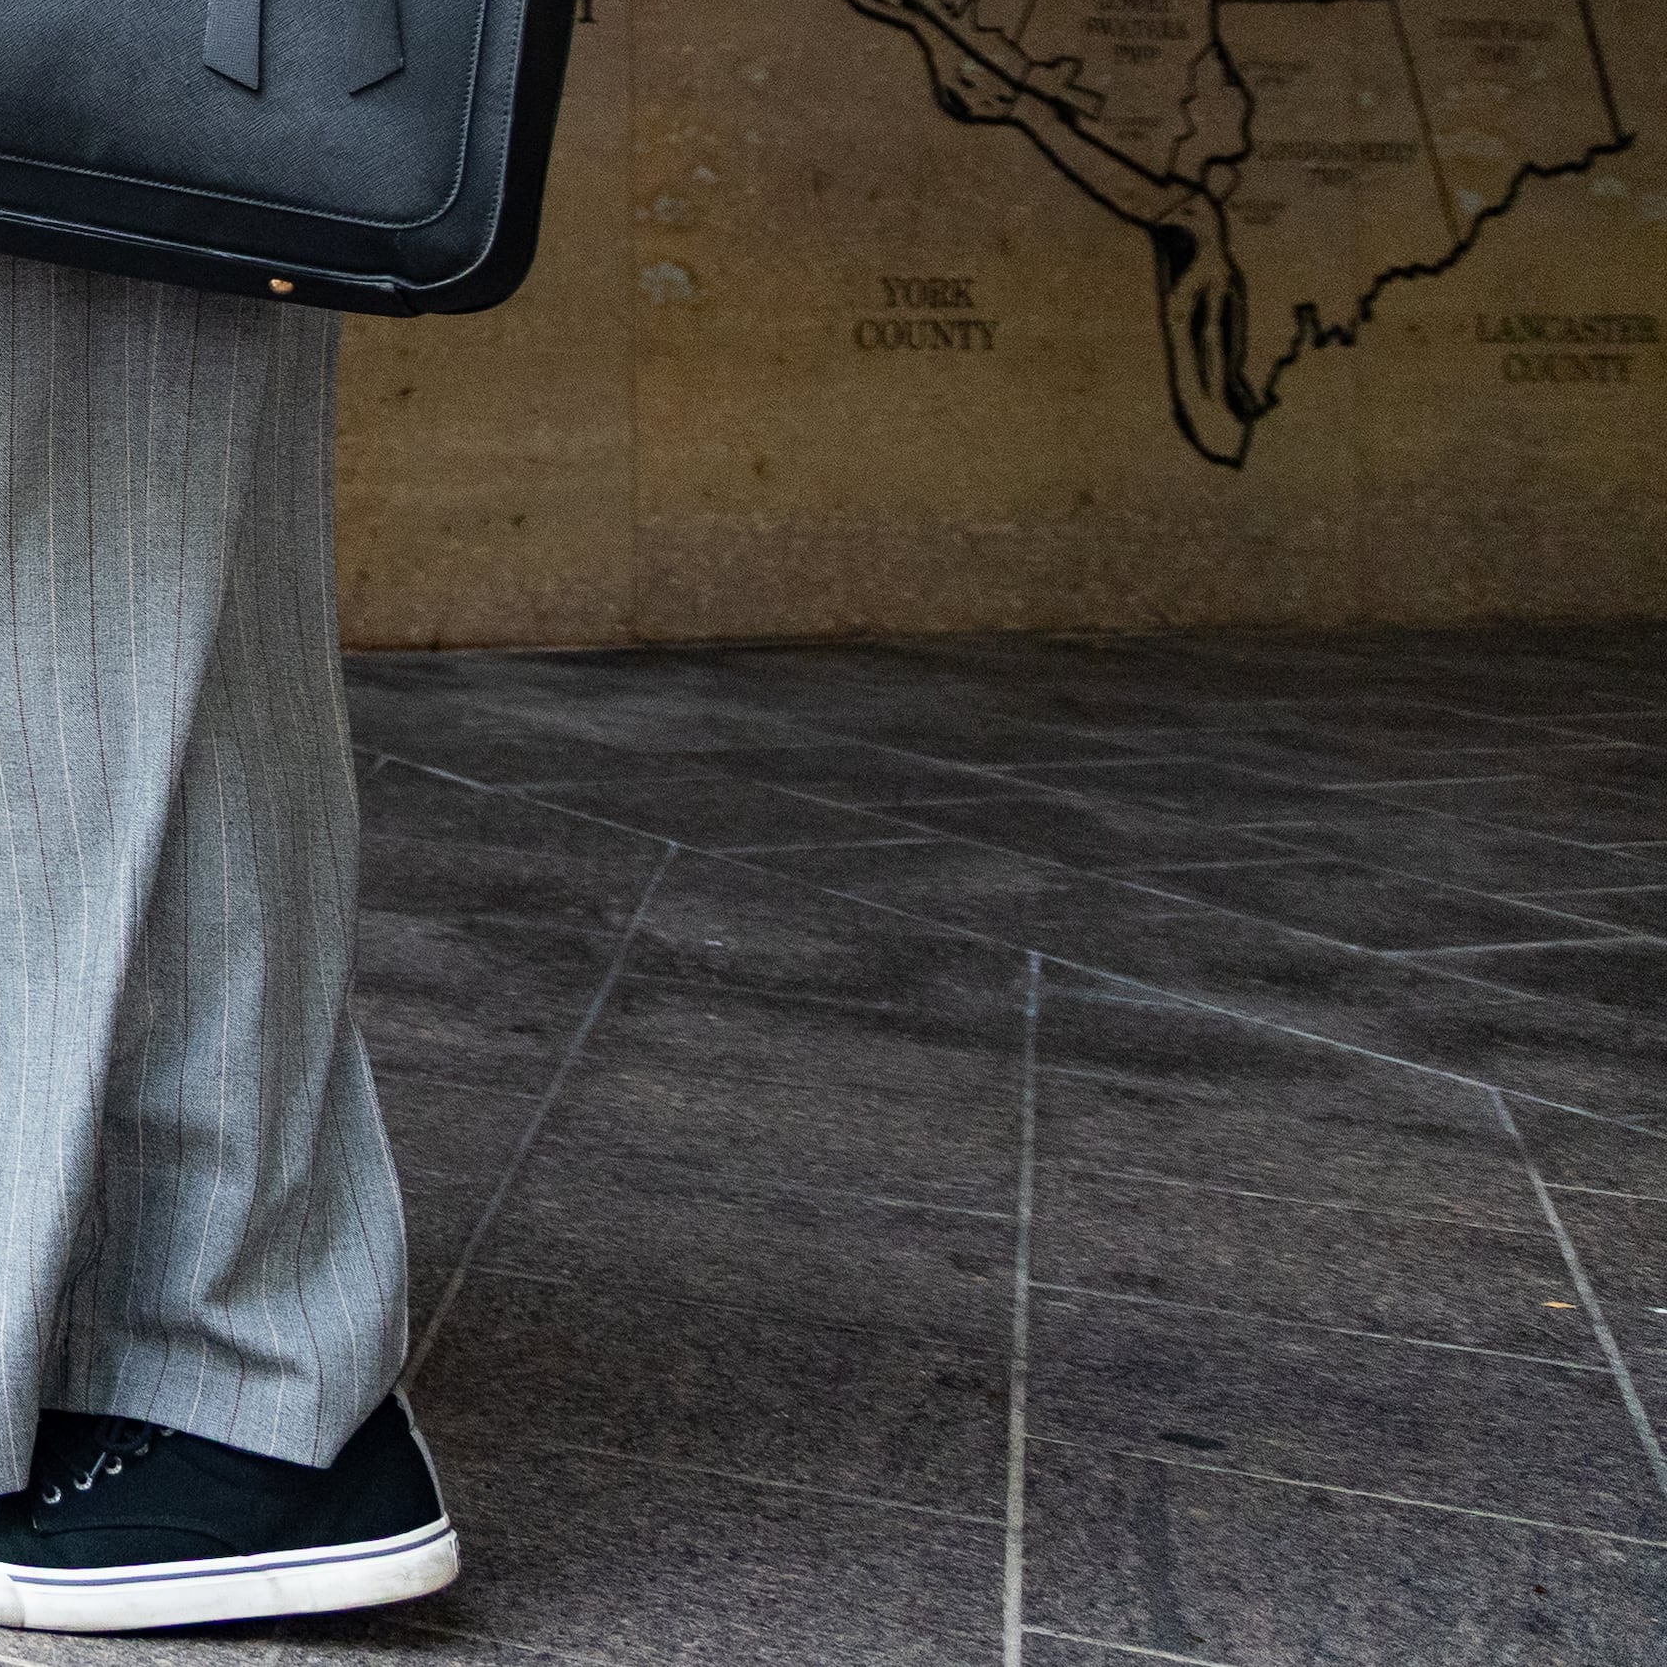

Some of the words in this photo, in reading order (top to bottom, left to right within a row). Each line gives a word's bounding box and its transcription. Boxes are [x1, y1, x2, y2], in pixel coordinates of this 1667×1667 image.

[880, 277, 975, 310] YORK
[853, 318, 999, 351] COUNTY
[1475, 312, 1662, 345] LANCASTER
[1501, 353, 1634, 384] COUNTY
